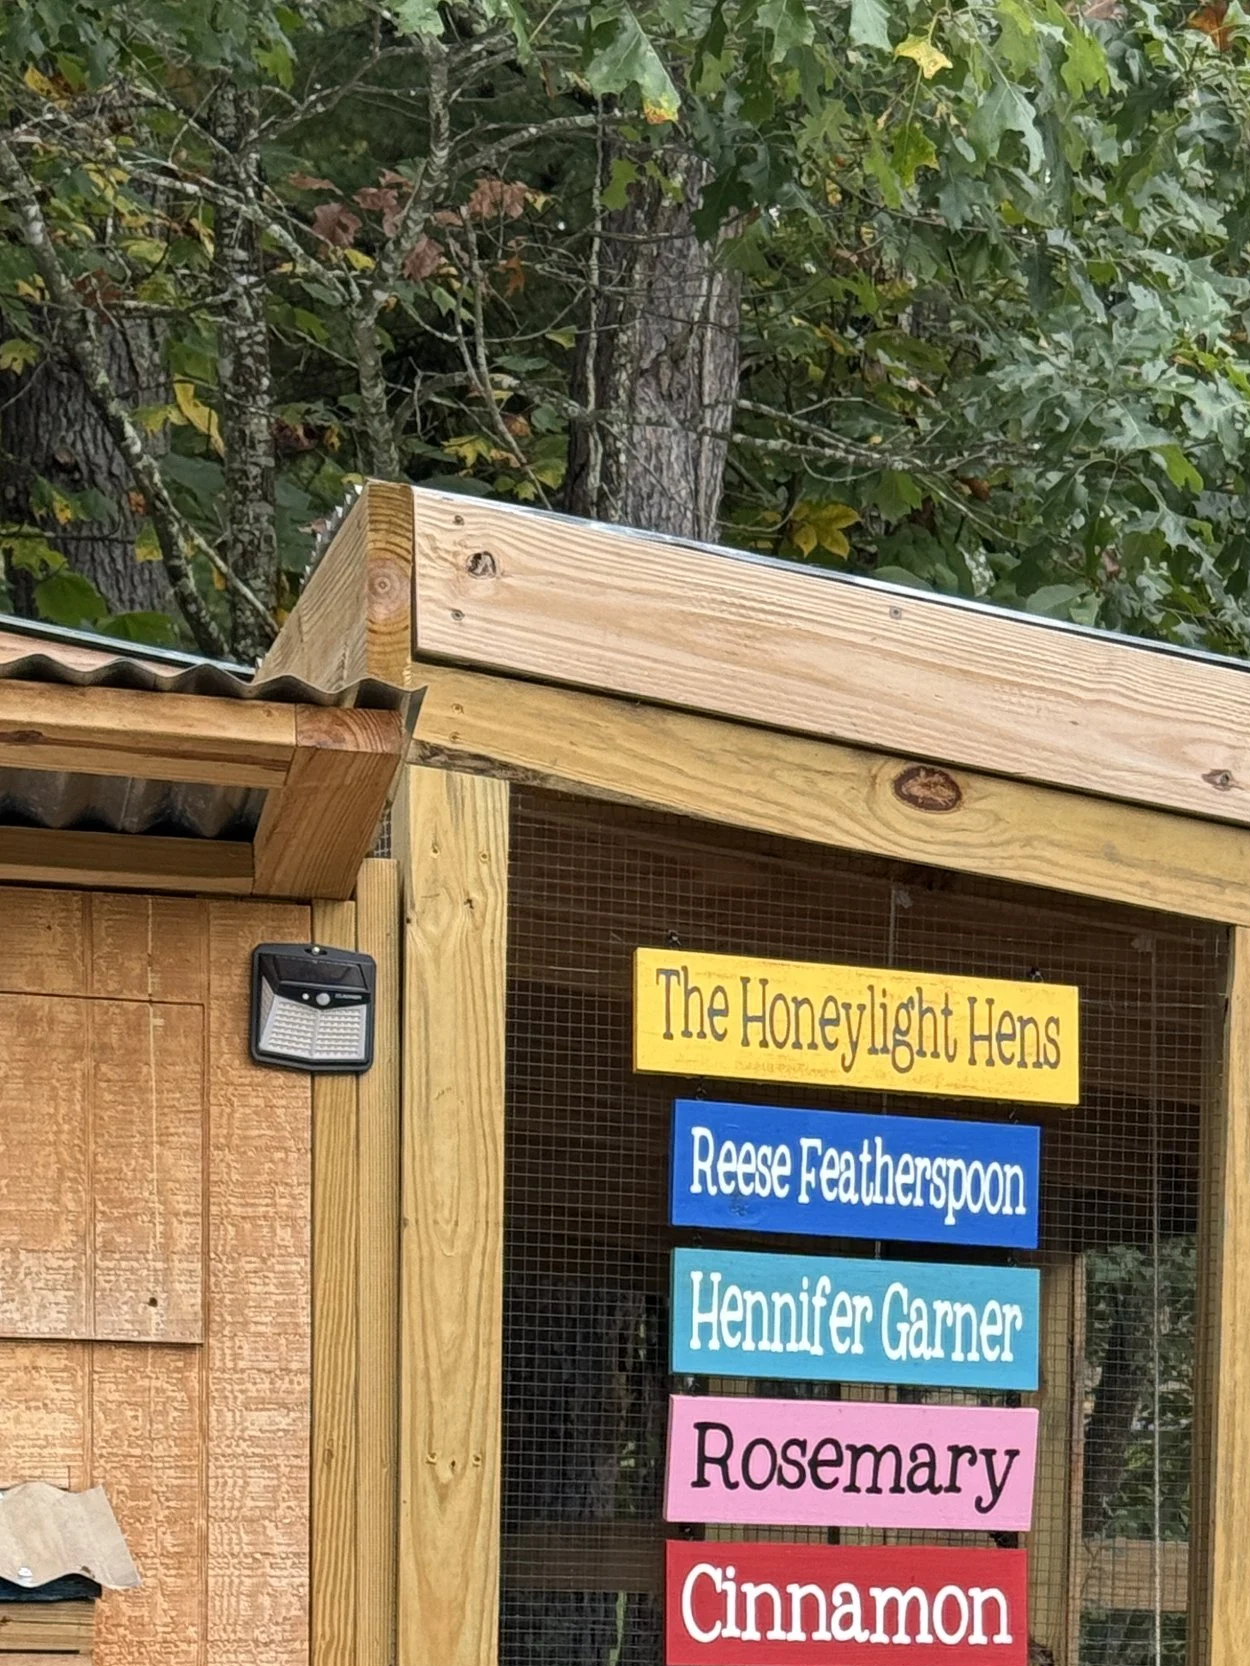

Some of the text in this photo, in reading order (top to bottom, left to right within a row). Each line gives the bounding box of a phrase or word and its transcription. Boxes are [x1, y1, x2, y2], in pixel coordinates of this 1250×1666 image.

[656, 966, 1061, 1074] The Honeylight Hens
[690, 1126, 1027, 1225] Reese Featherspoon
[689, 1270, 1023, 1362] Hennifer Garner
[690, 1421, 1020, 1514] Rosemary
[681, 1563, 1013, 1645] Cinnamon
